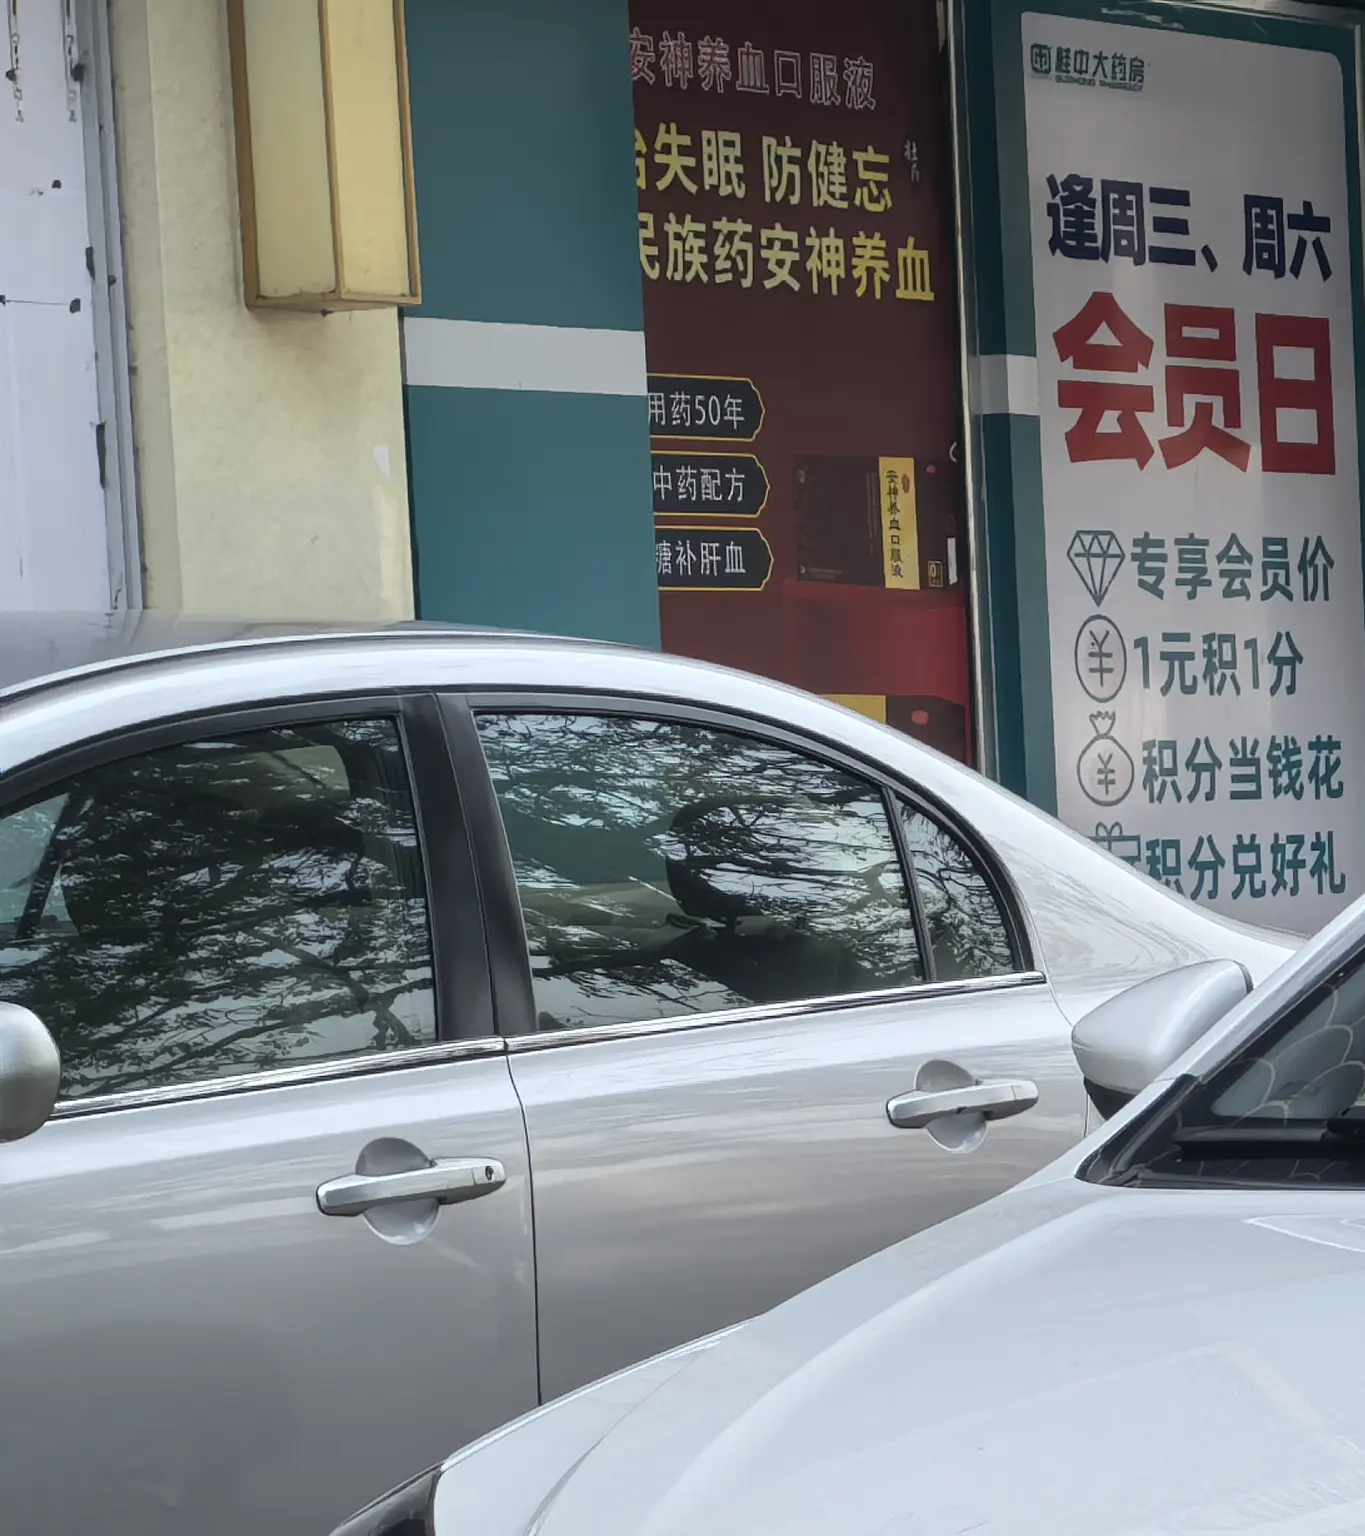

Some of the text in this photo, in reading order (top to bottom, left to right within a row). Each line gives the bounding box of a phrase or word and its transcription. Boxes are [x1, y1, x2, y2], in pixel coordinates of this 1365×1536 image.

[761, 135, 893, 213] 防健忘
[1045, 173, 1333, 283] 逢周三、周六
[1052, 291, 1336, 475] 会员日
[652, 465, 746, 503] 中药配方
[1130, 531, 1335, 602] 专享会员价
[1133, 631, 1304, 698] 1元积1分
[1142, 735, 1345, 805] 积分当钱花
[1146, 830, 1347, 901] 积分兑好礼
